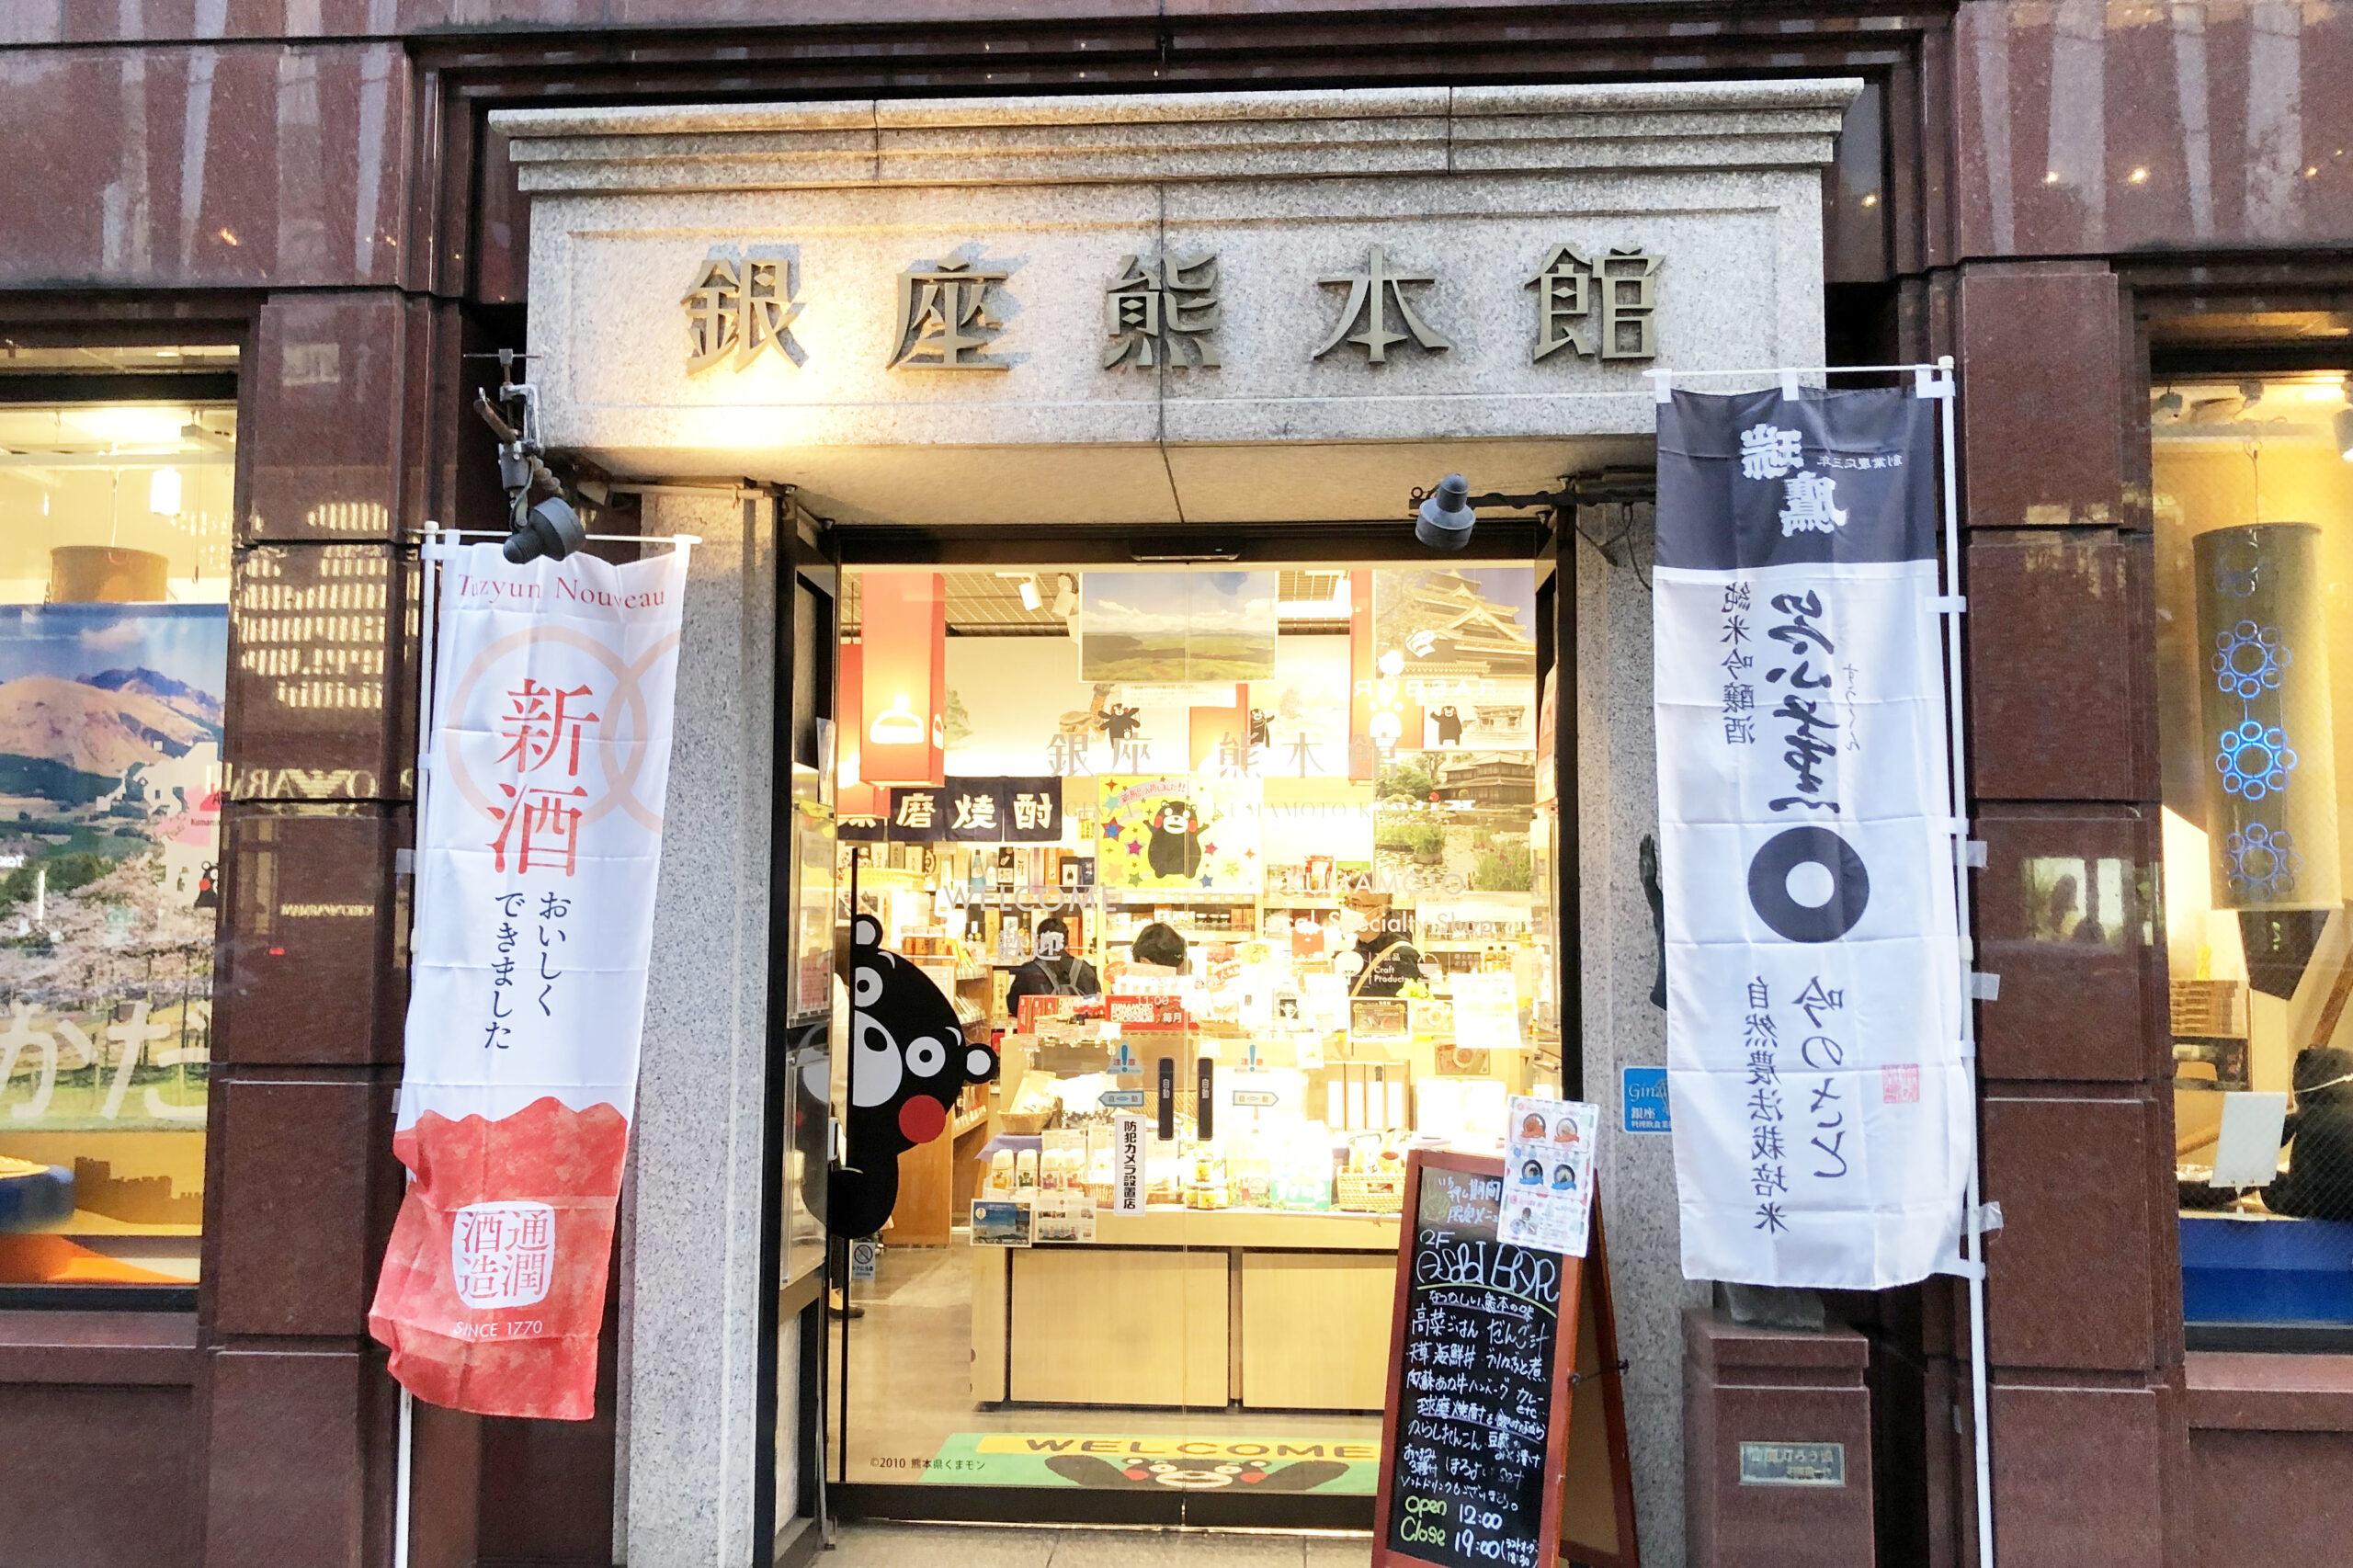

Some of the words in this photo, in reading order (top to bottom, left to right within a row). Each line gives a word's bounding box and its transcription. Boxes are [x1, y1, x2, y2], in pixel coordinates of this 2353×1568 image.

[680, 243, 1665, 372] 銀座熊本館
[556, 576, 665, 609] Nouveau
[1047, 732, 1400, 778] 銀座熊本館
[485, 678, 599, 877] 新酒
[944, 885, 1118, 912] WELCOME
[484, 893, 525, 1049] できました
[539, 892, 571, 1017] おいしく
[1374, 965, 1395, 974] Craft
[1123, 1120, 1137, 1210] 防犯カメラ設置店
[460, 1210, 506, 1299] 酒造
[504, 1210, 549, 1299] 通潤
[1420, 1229, 1455, 1249] 2F
[453, 1321, 497, 1337] SINCE
[506, 1320, 542, 1335] 1770
[911, 1457, 985, 1471] 熊本県くまモン
[1026, 1438, 1374, 1460] WELCOME
[1400, 1516, 1446, 1547] Close
[1455, 1528, 1500, 1557] 19:00
[1459, 1504, 1503, 1530] 12:00
